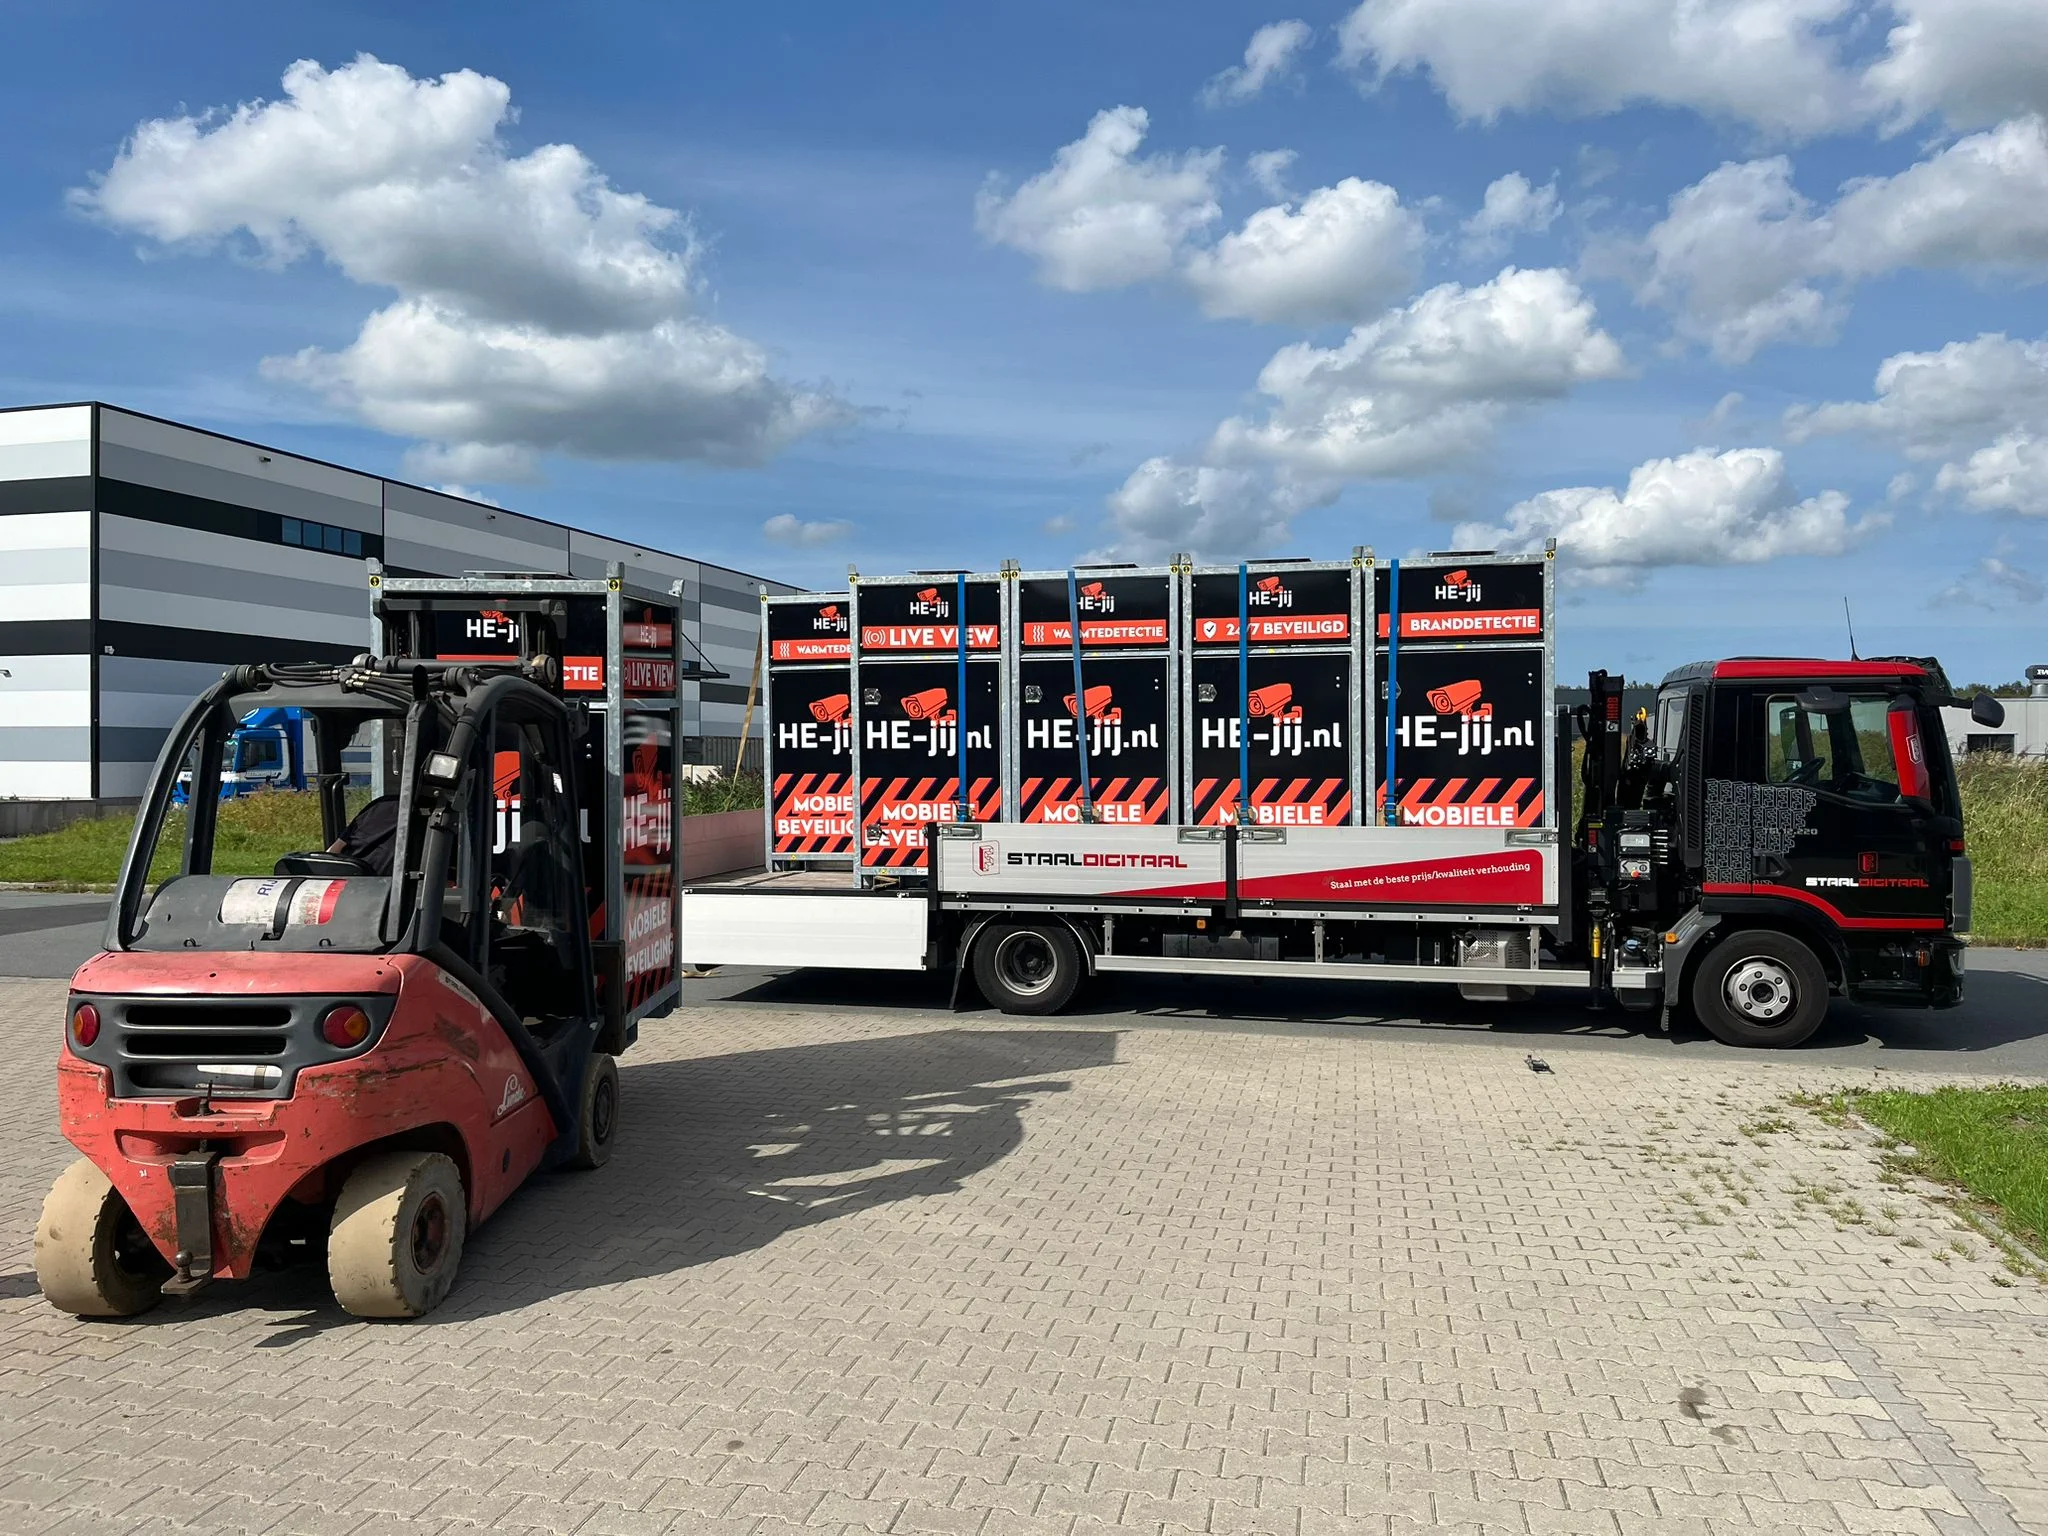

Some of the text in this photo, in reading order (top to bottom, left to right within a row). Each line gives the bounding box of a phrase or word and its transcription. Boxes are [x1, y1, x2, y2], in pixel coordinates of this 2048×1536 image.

[1249, 590, 1293, 608] HE-jij
[1435, 584, 1481, 602] HE-jij
[910, 601, 949, 618] HE-jij
[813, 617, 847, 632] HE-jij
[1263, 620, 1344, 635] BEVEILIGD
[1410, 615, 1536, 631] BRANDDETECTIE
[889, 628, 934, 646] LIVE
[1053, 626, 1164, 639] WAMTEDETECTIE
[796, 644, 851, 654] WARMTEDE
[632, 661, 674, 688] LIVE VIEW
[866, 720, 992, 757] HE-jijnl
[1027, 719, 1159, 756] HE-jij.nl
[1202, 718, 1342, 756] HE-jij.nl
[1385, 715, 1535, 756] HE-jij.nl
[794, 796, 852, 812] MOBIE
[1044, 804, 1142, 823] MOELE
[1219, 805, 1324, 824] MBIELE
[1404, 806, 1515, 826] MOBIELE
[1007, 852, 1188, 868] STAALDIGITAAL
[1330, 862, 1531, 890] Staal met de beste prijs/kwaliteit verhouding
[1805, 877, 1929, 888] STAALDIGITAAL
[628, 901, 667, 943] MOBIELE
